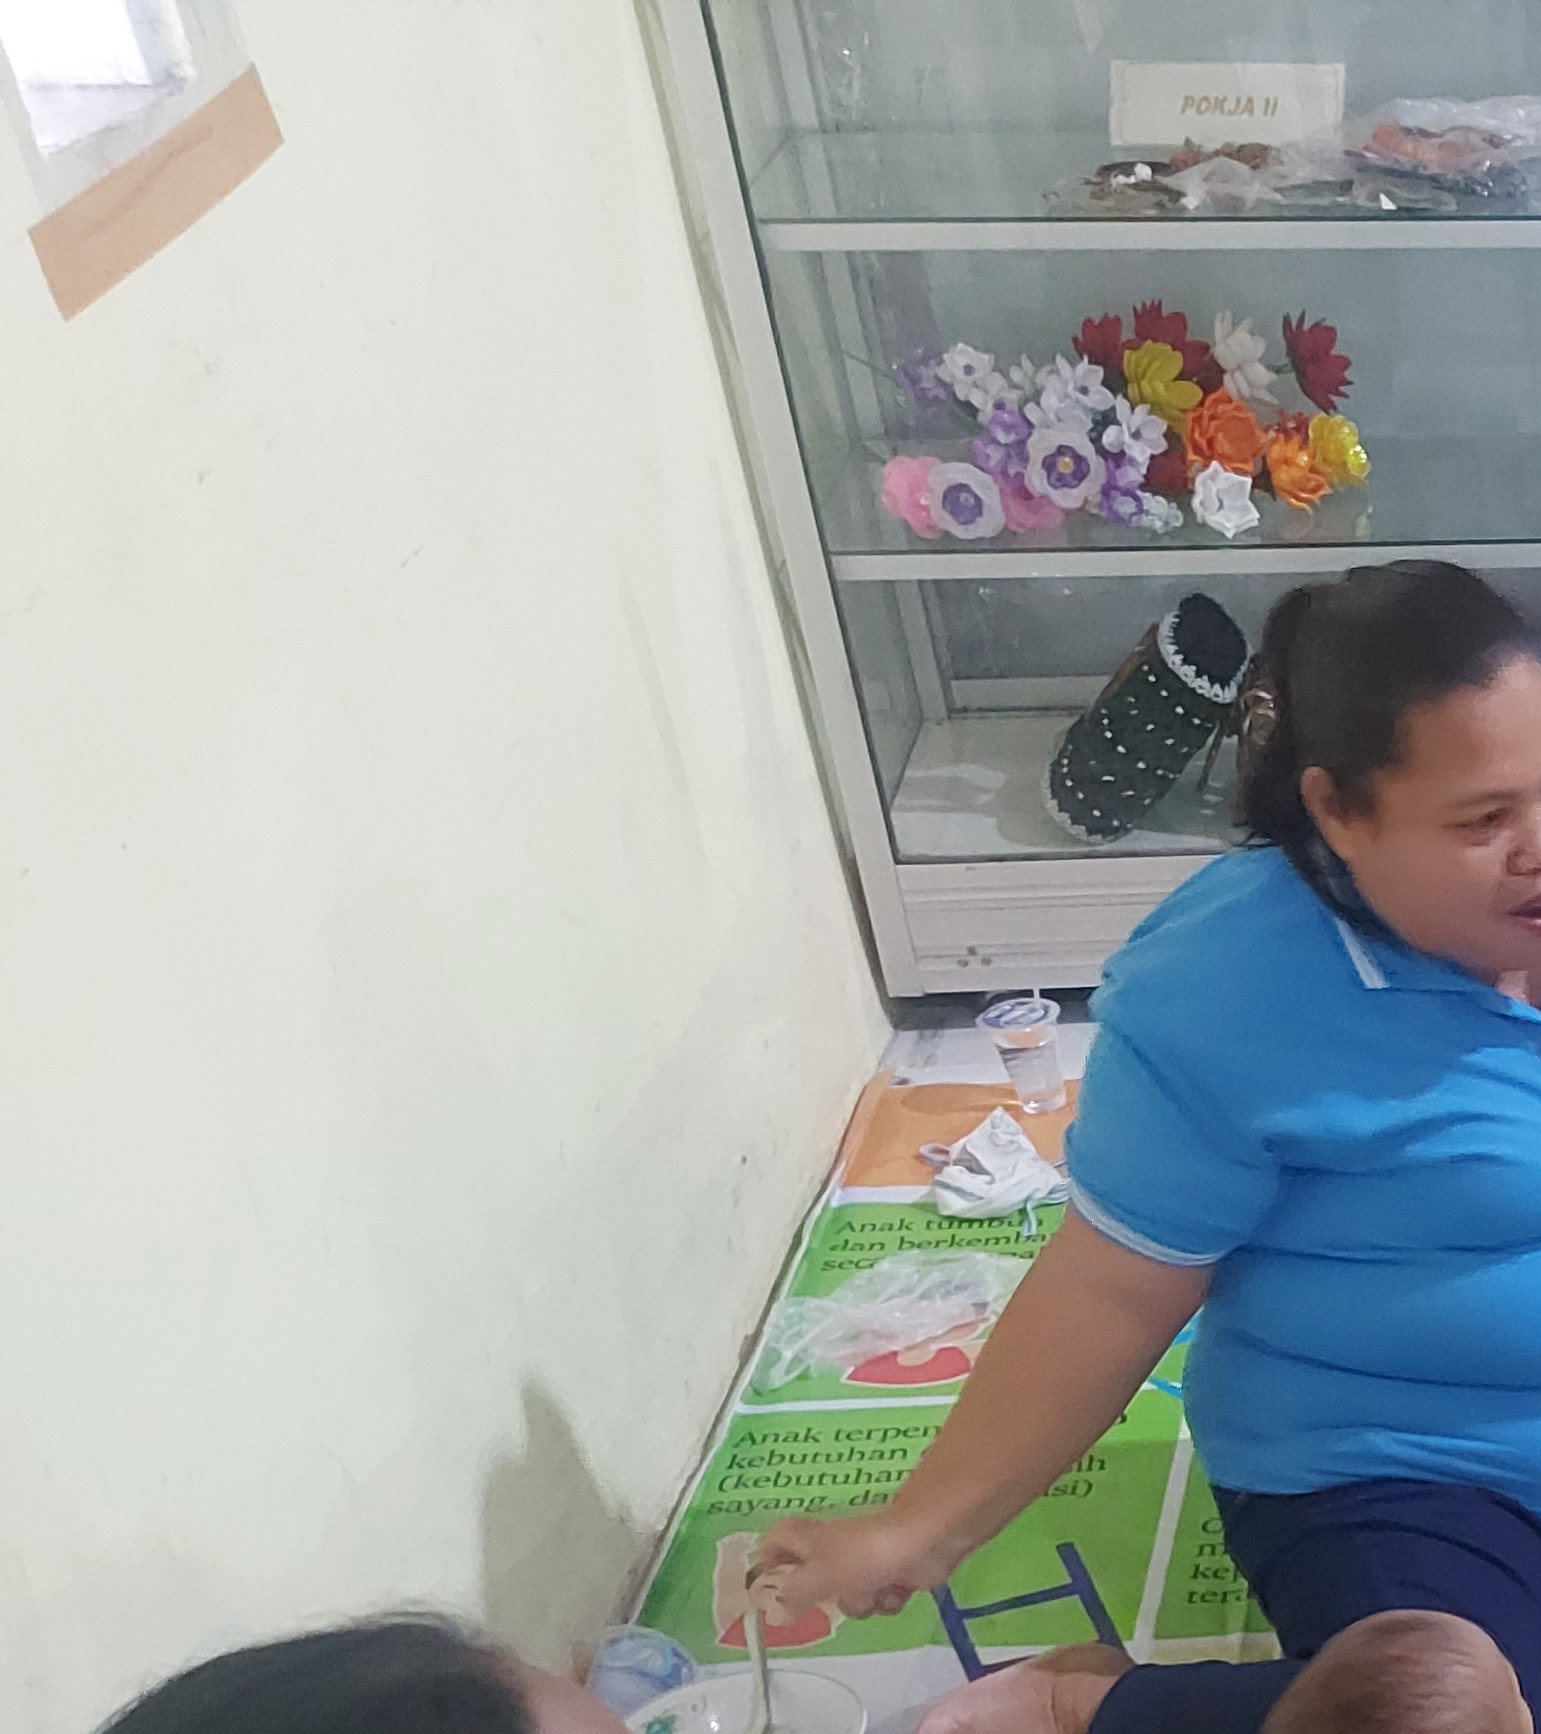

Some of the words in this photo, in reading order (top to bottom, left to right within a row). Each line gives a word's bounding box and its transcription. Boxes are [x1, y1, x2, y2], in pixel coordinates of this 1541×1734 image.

[1181, 95, 1255, 117] POKJA
[836, 1217, 915, 1235] Anak
[829, 1239, 886, 1252] dan
[732, 1426, 826, 1447] Anak
[726, 1446, 908, 1471] kebutuhan
